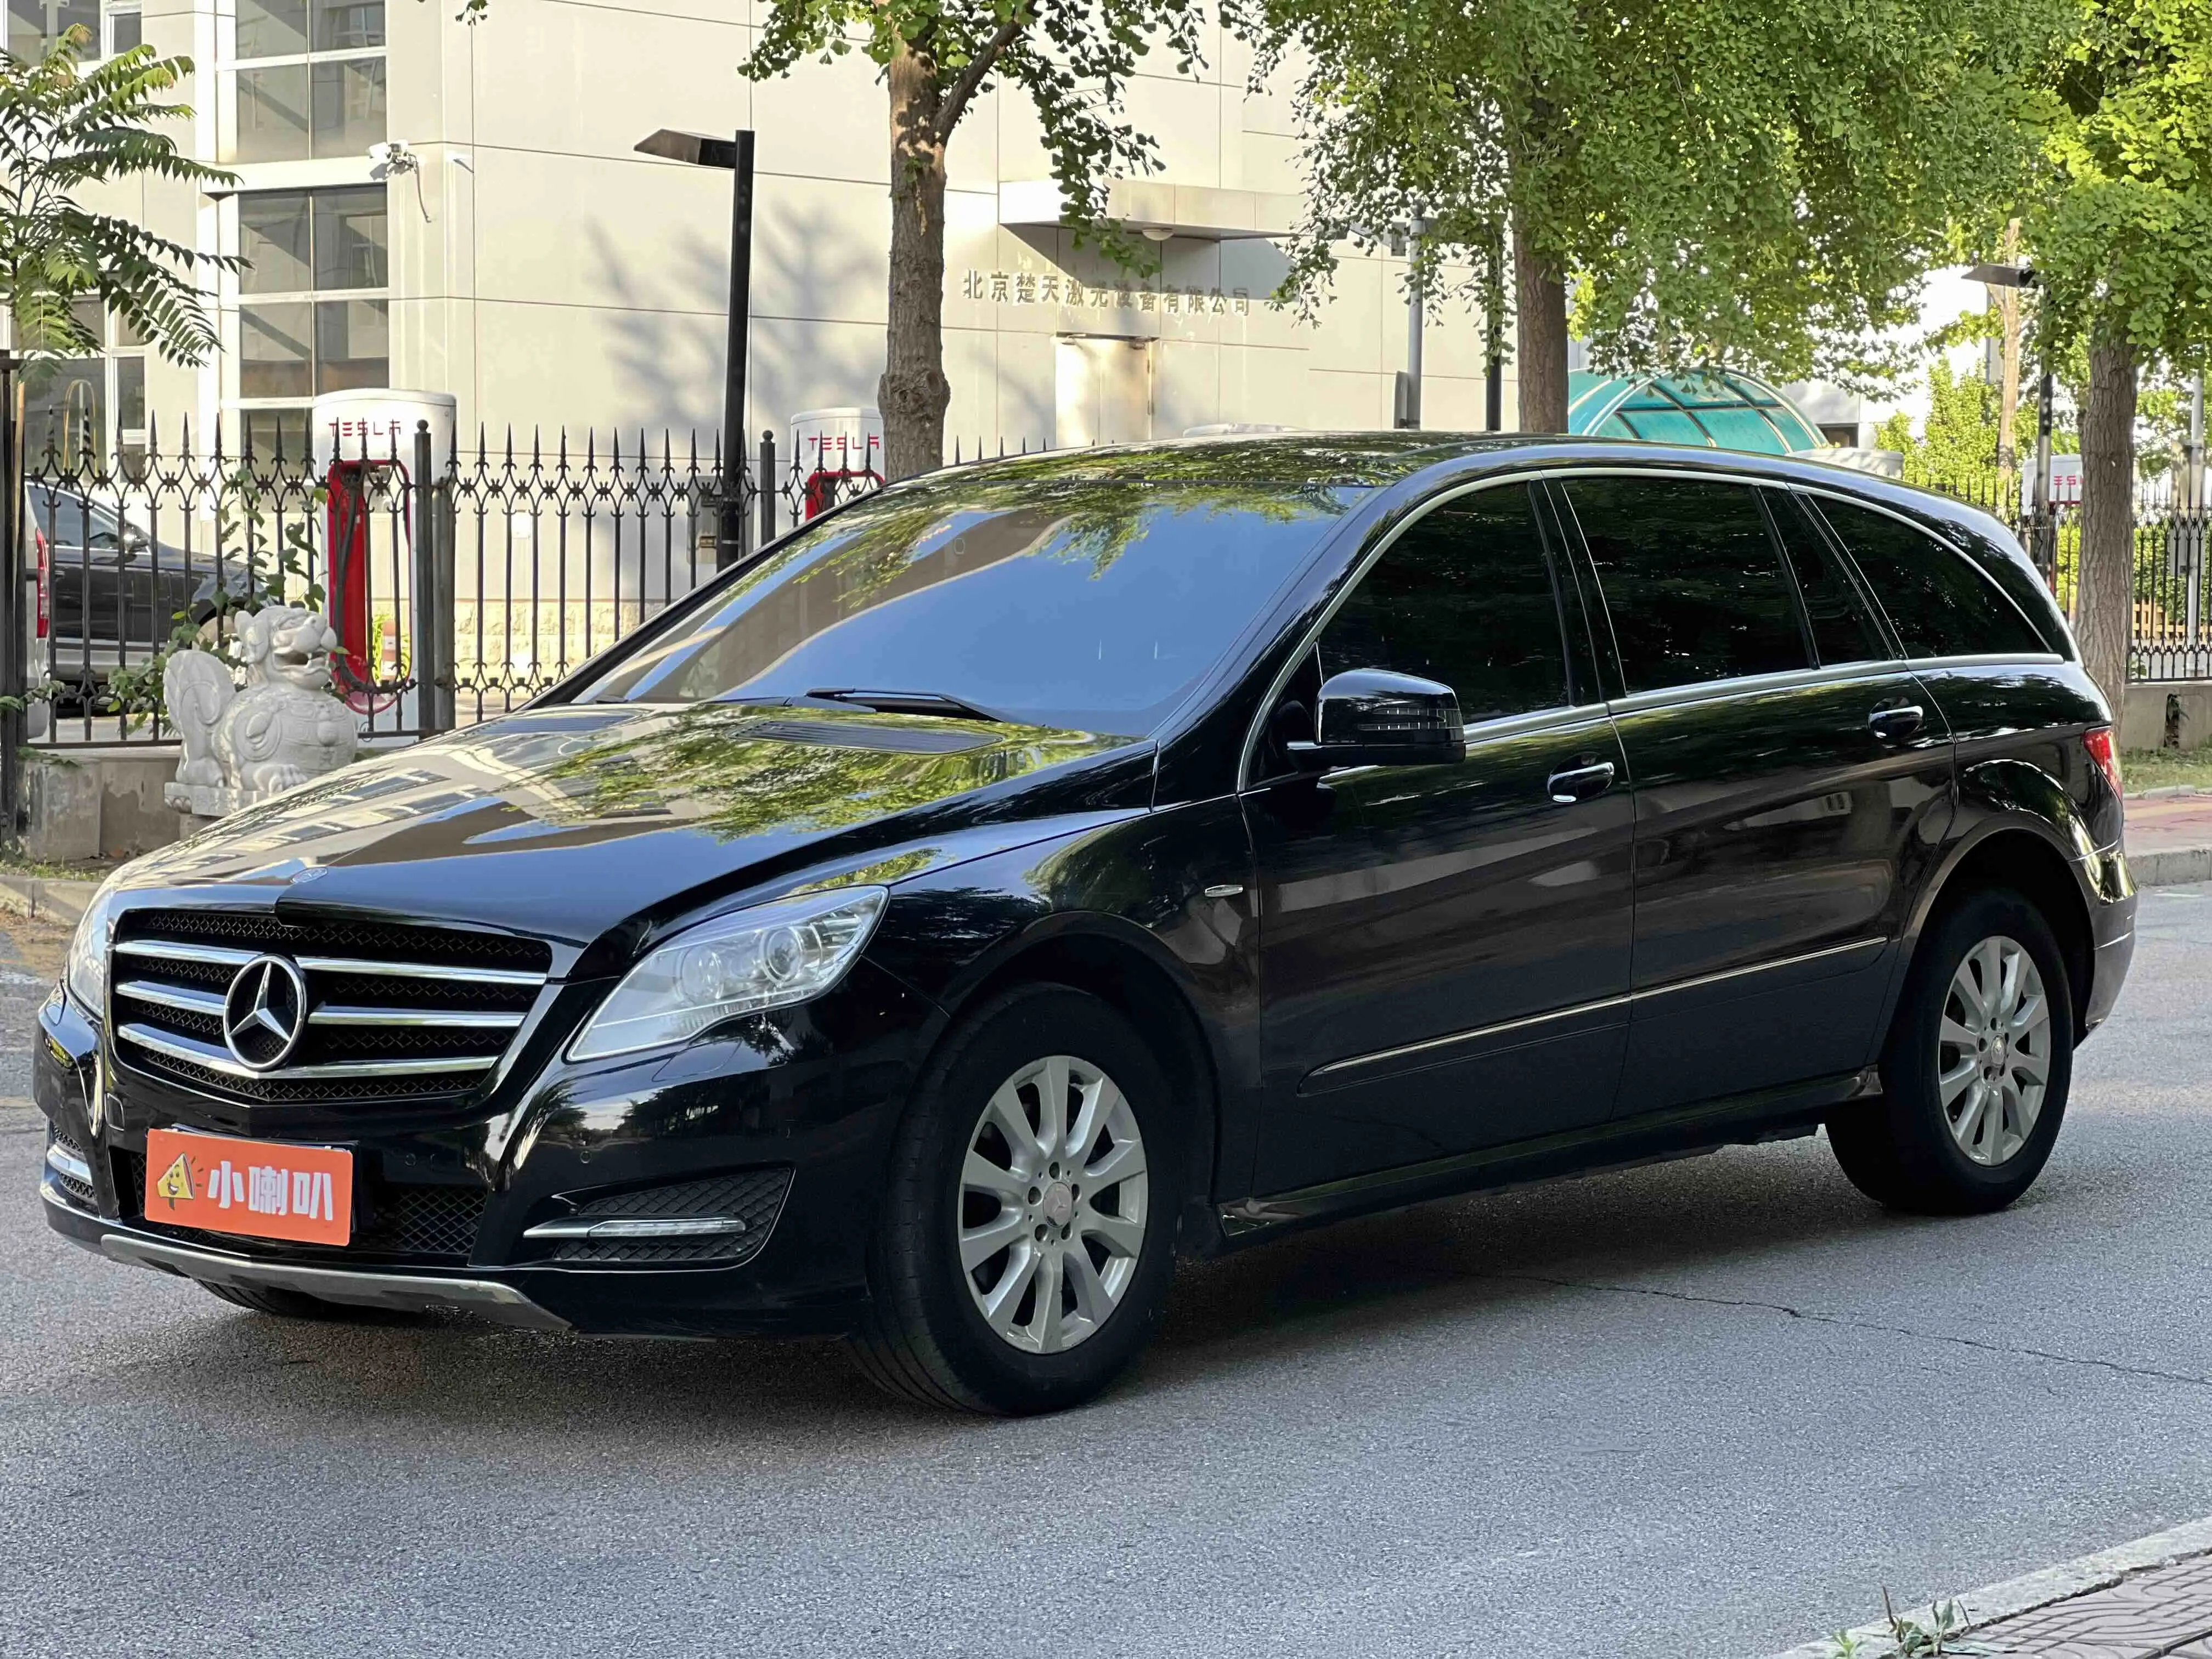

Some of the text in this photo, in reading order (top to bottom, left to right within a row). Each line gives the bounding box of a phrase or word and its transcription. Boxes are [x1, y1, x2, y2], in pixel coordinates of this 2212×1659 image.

[328, 420, 402, 437] TESLA
[808, 436, 879, 450] TESLA
[207, 1160, 333, 1221] 小喇叭
